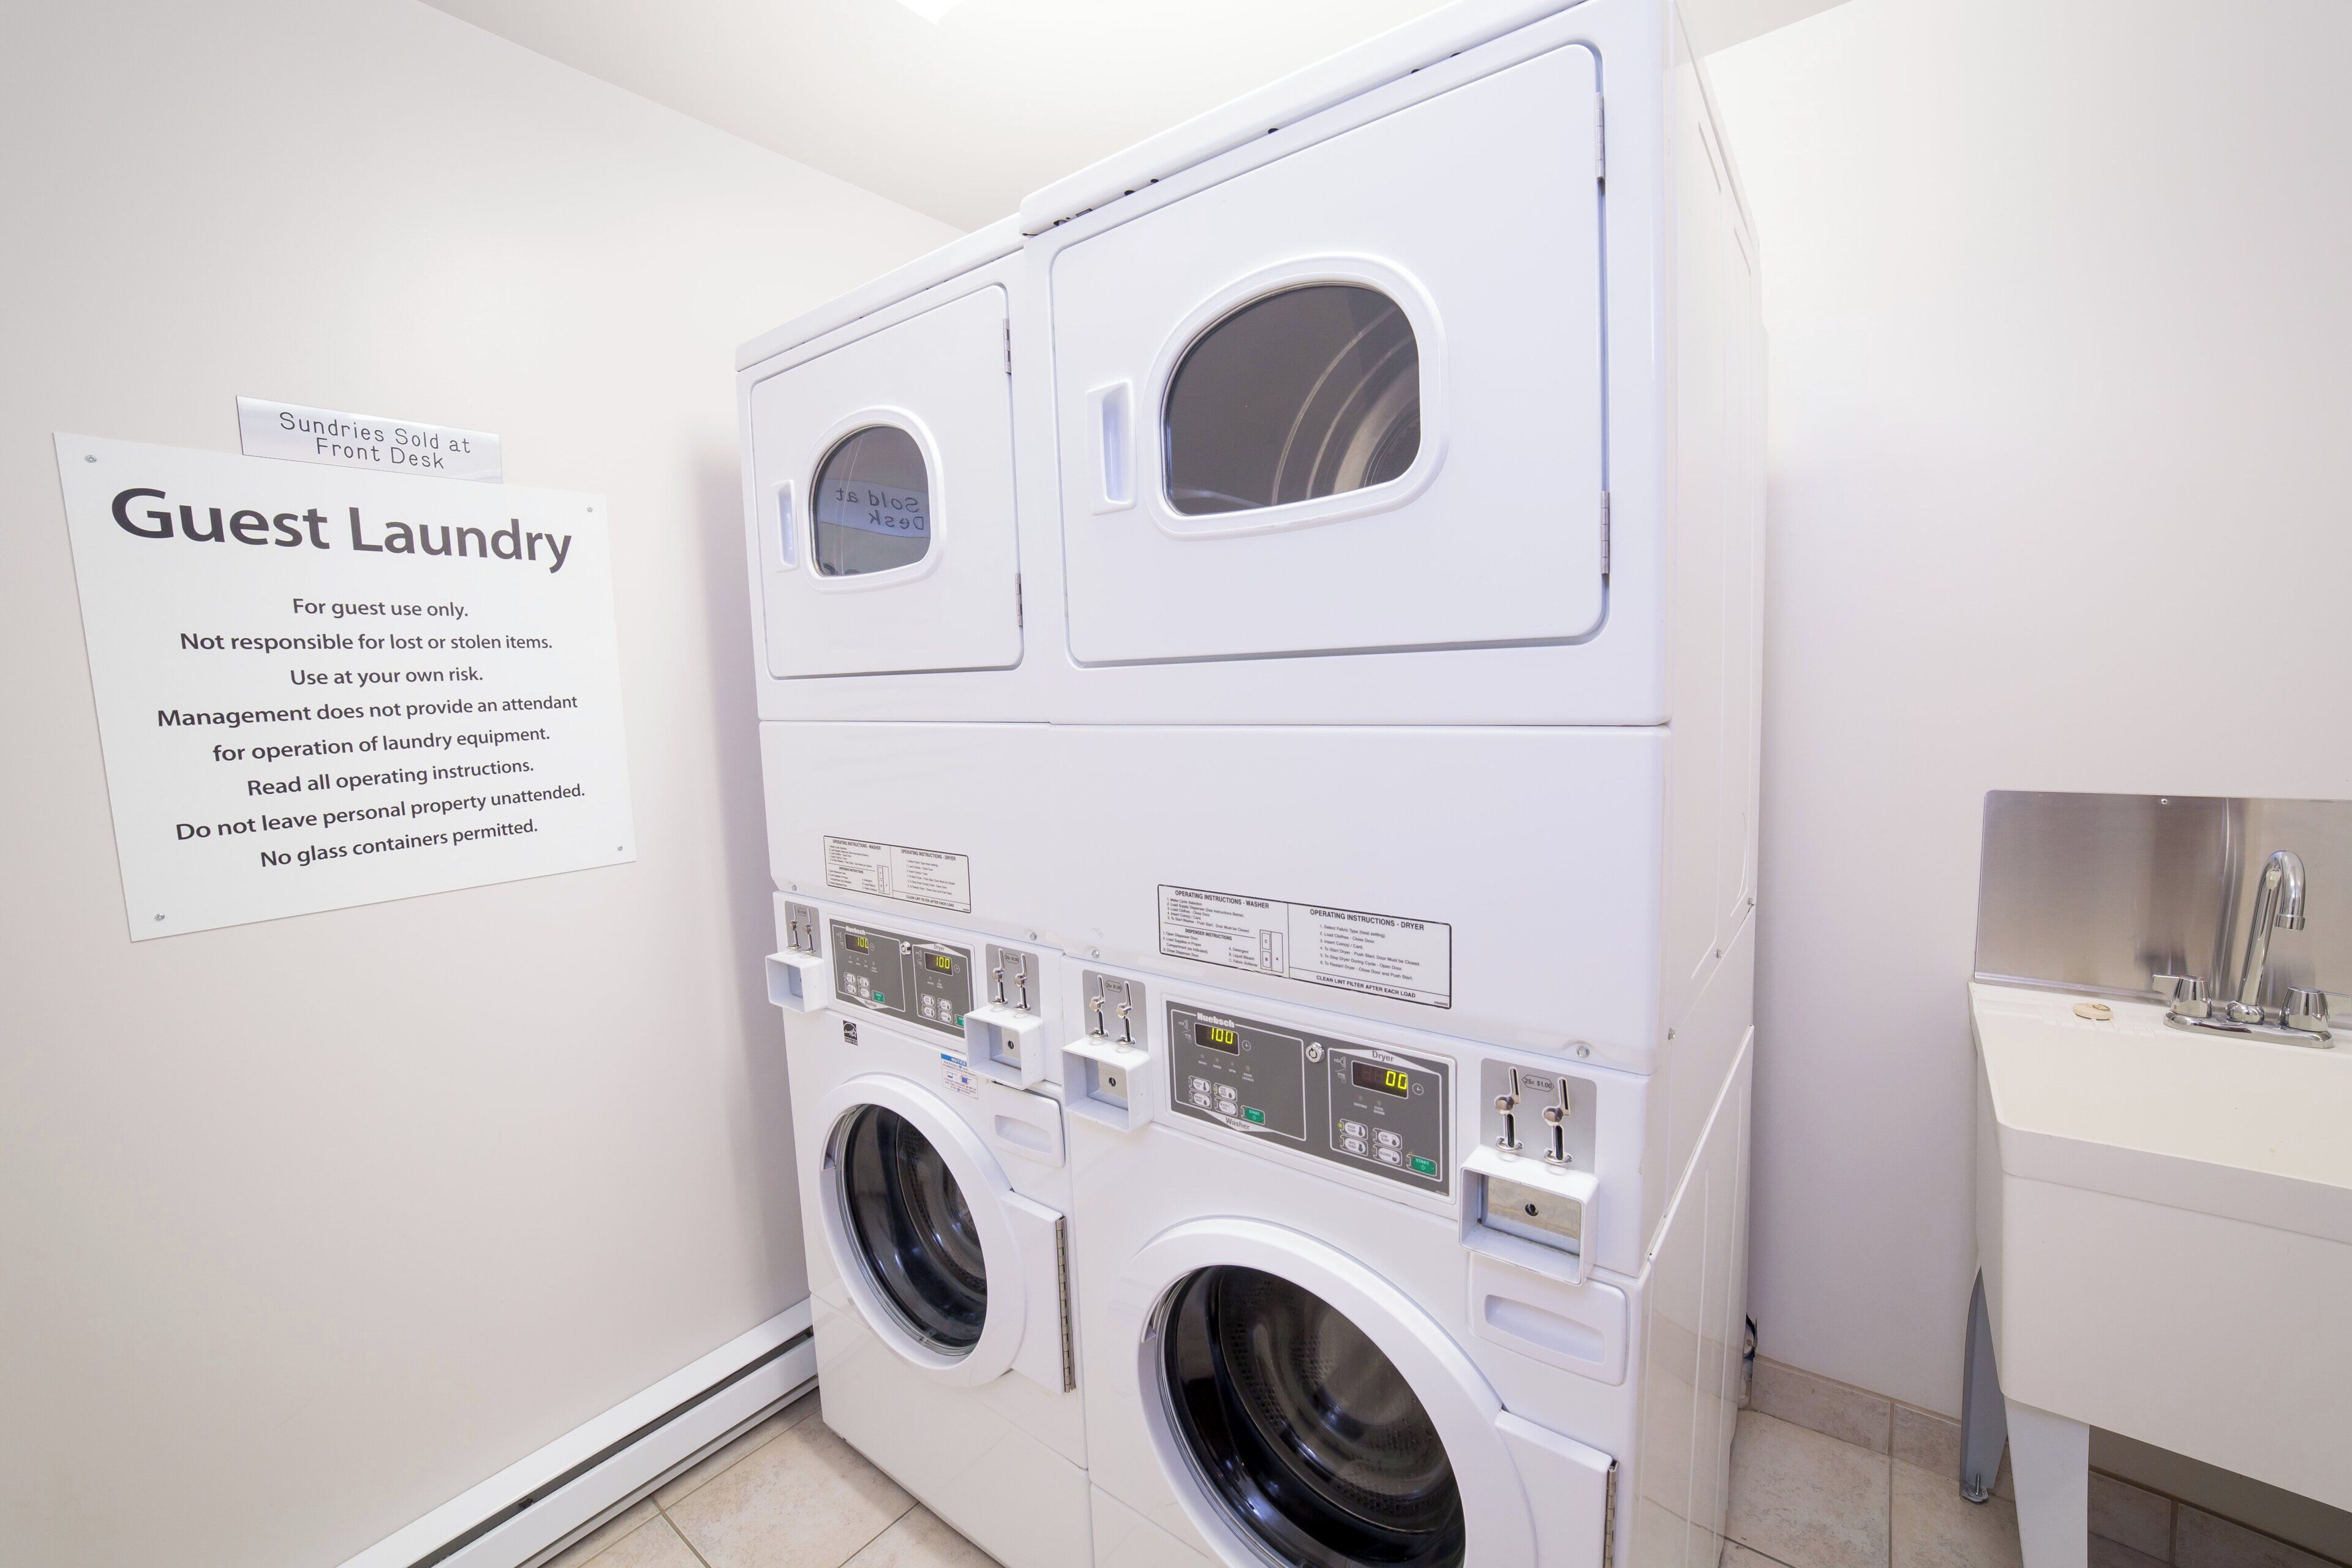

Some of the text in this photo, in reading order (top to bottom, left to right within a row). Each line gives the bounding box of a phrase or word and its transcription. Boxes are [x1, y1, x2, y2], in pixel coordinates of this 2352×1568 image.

[279, 412, 470, 454] Sundries Sold at
[316, 437, 444, 469] Front Desk
[111, 488, 572, 574] Guest Laundry
[293, 598, 469, 620] For guest use only.
[180, 633, 552, 654] Not responsible for lost or stolen items.
[290, 666, 483, 688] Use at your own risk.
[157, 695, 578, 728] Management does not provide an attendant
[212, 728, 550, 763] for operation of laundry equipment.
[247, 760, 534, 796] Read all operating instructions.
[176, 783, 585, 840] Do not leave personal property unattended.
[260, 818, 538, 867] No glass containers permitted.
[1175, 890, 1203, 899] OPERATING
[1204, 894, 1242, 905] INSTRUCTIONS
[1310, 909, 1345, 919] OPERATING
[1348, 914, 1394, 926] INSTRUCTIONS
[1401, 922, 1423, 930] DRYER
[937, 957, 949, 969] 100
[1197, 1013, 1234, 1028] Huebsch
[1212, 1028, 1234, 1044] 100
[951, 1057, 966, 1066] NOTICE
[1372, 1051, 1394, 1062] Dryer
[1385, 1071, 1407, 1090] 00
[1226, 1117, 1250, 1130] Washer
